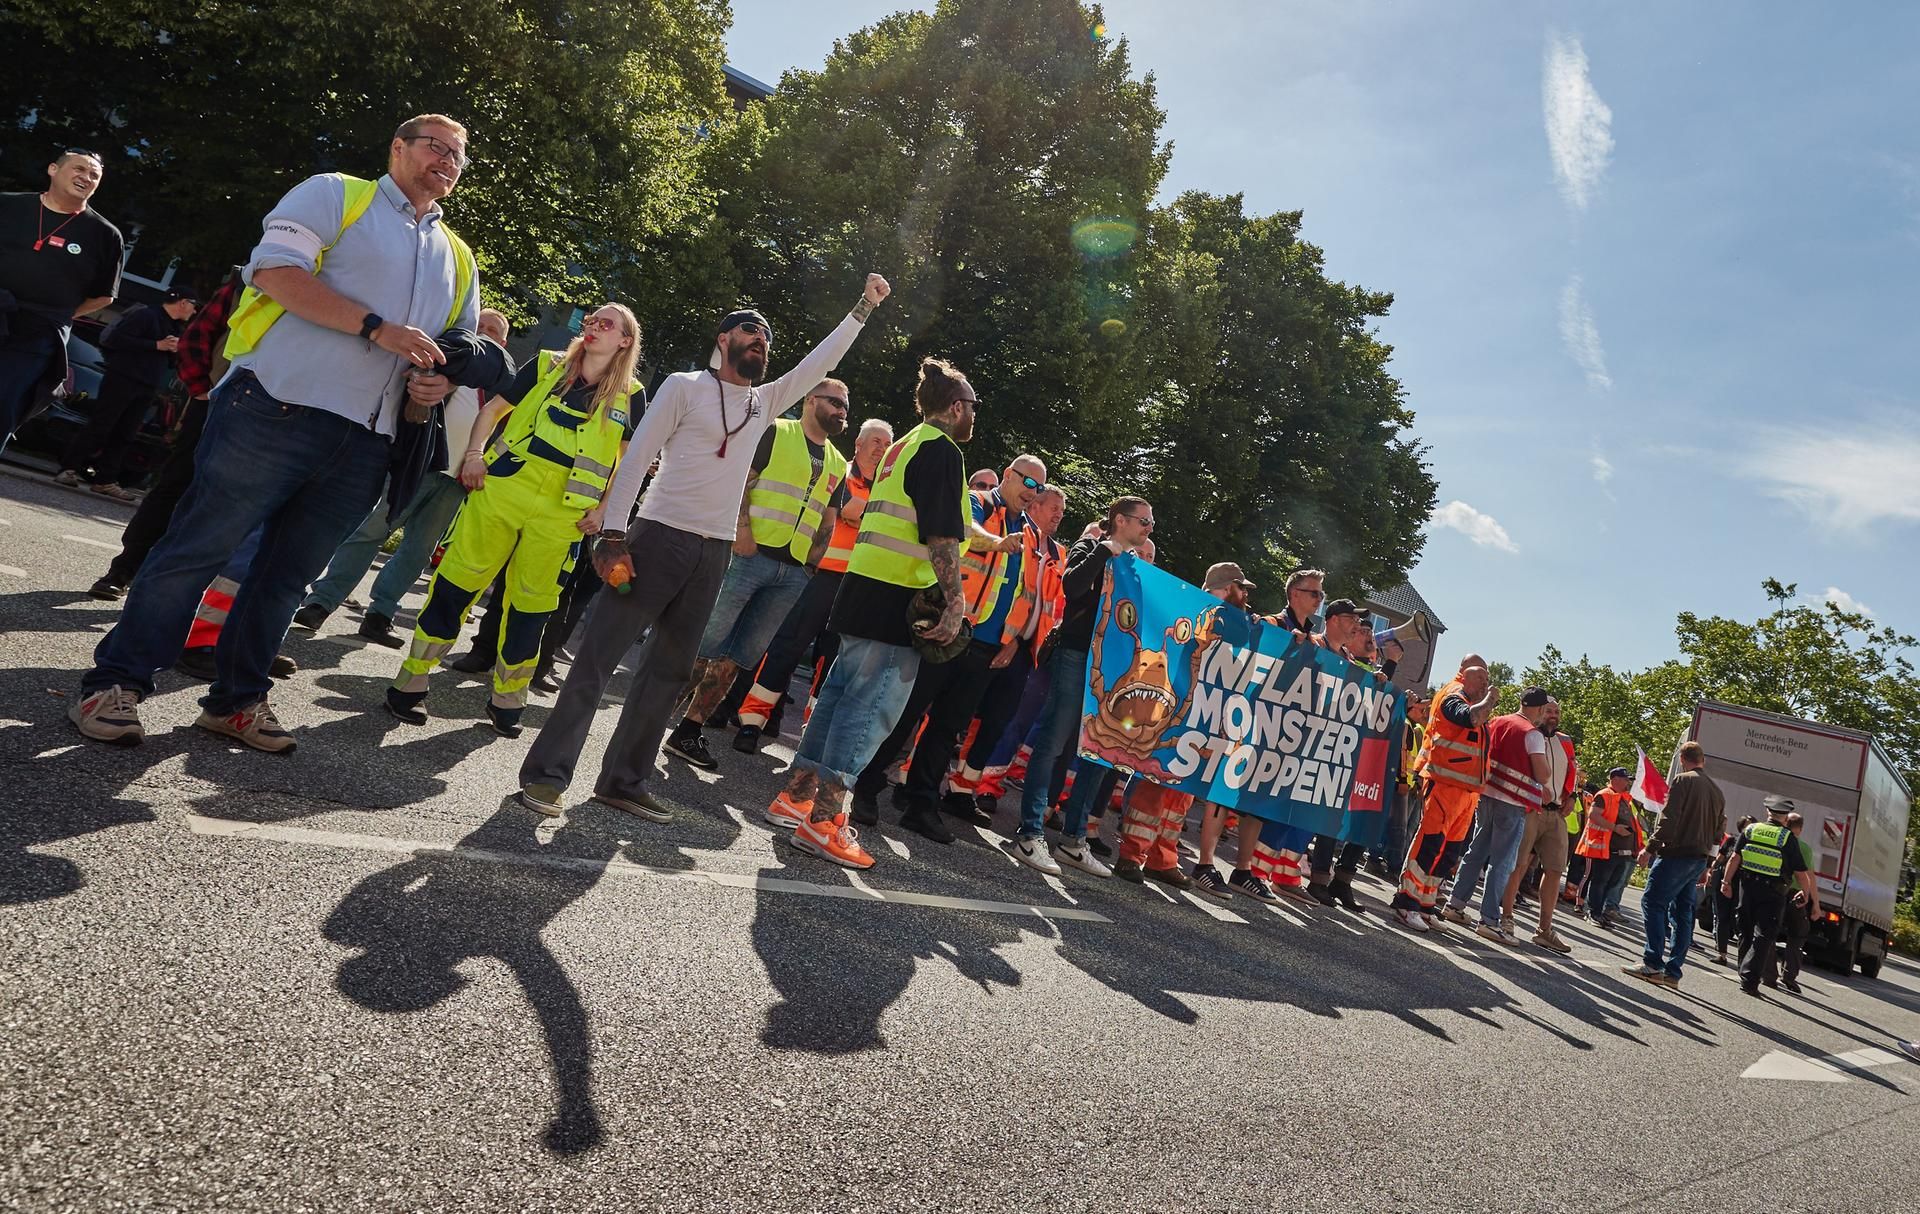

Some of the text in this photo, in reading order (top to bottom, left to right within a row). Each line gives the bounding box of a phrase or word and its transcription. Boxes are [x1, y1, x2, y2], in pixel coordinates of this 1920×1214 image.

[1186, 682, 1359, 767] MONSTER
[1198, 640, 1393, 733] INFLATIONS
[1167, 730, 1352, 809] STOPPEN!
[1744, 738, 1794, 758] CharterWay
[1745, 728, 1809, 750] Mercedes-Benz
